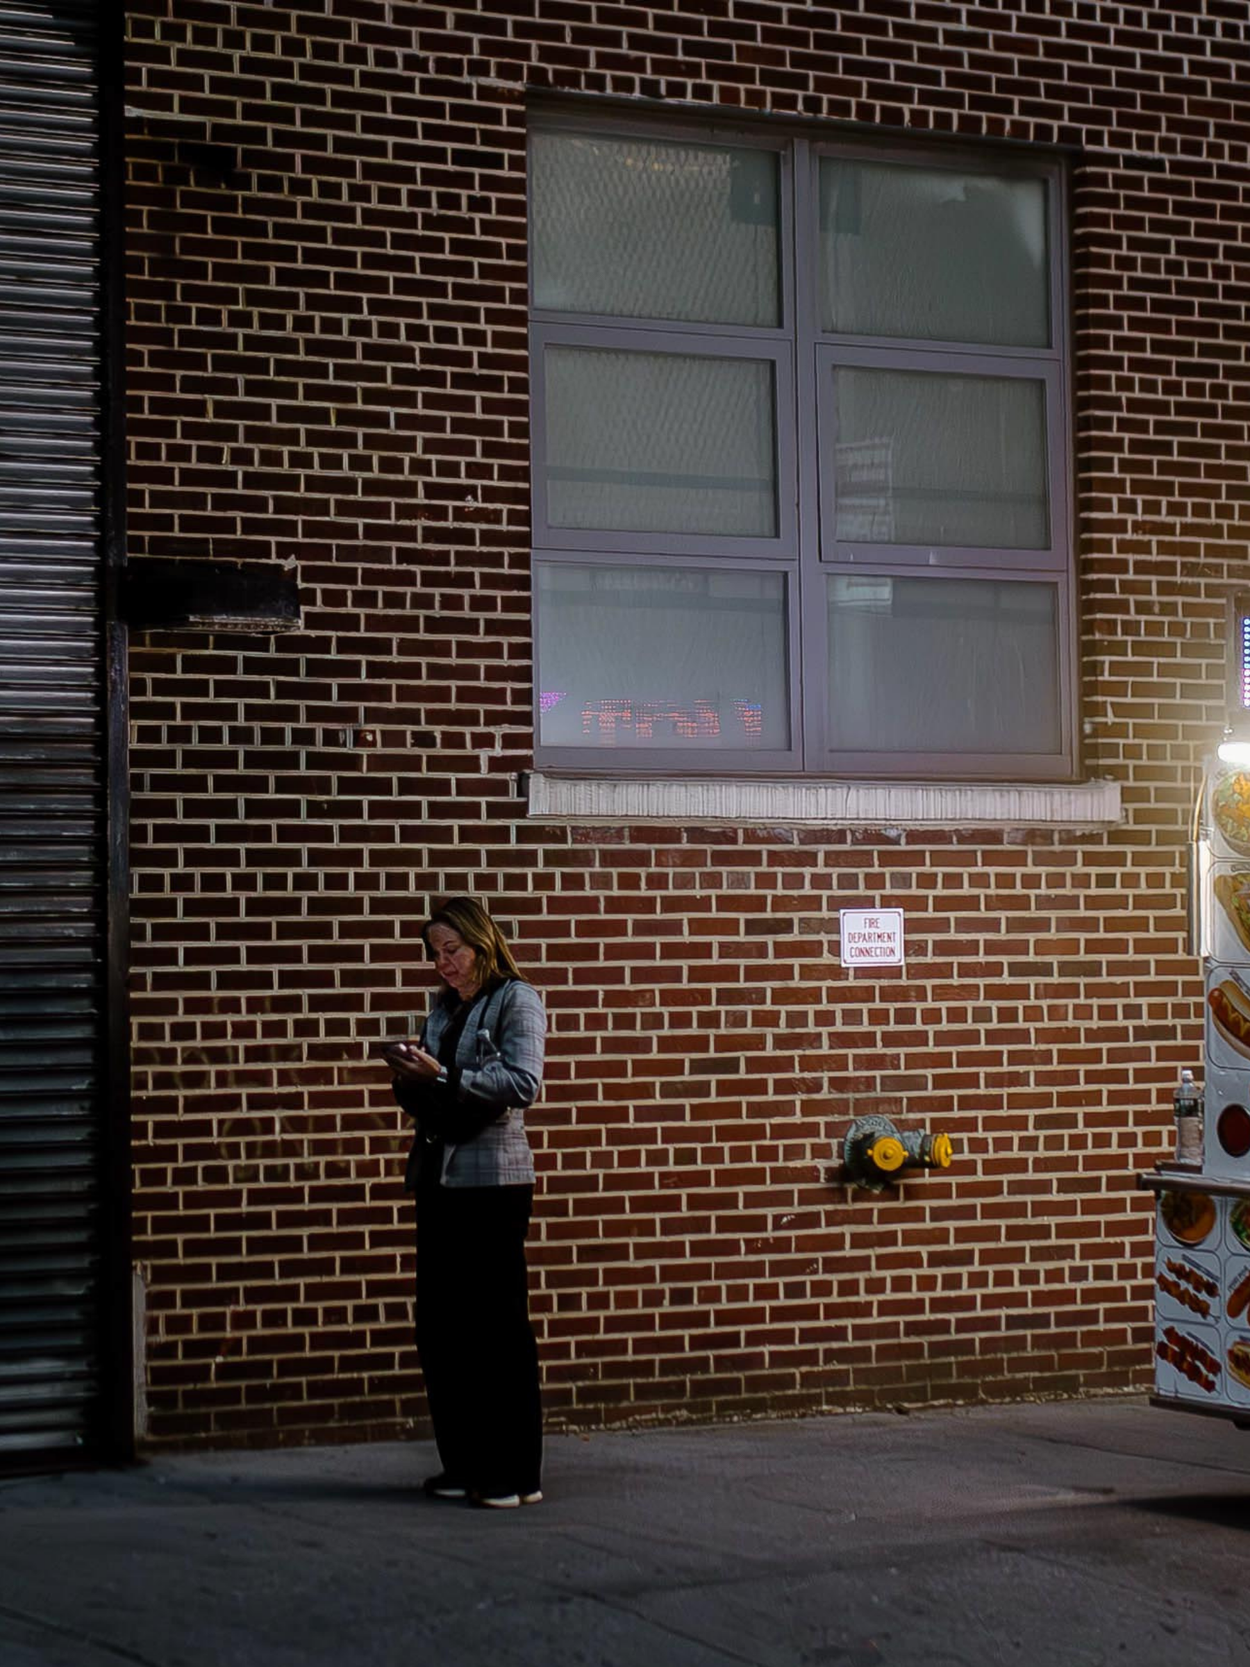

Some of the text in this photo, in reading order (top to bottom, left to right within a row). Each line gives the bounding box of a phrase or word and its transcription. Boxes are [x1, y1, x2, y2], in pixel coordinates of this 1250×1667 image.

[863, 917, 881, 929] FIRE
[847, 932, 896, 944] DEPARTMENT
[849, 946, 896, 958] CONNECTION
